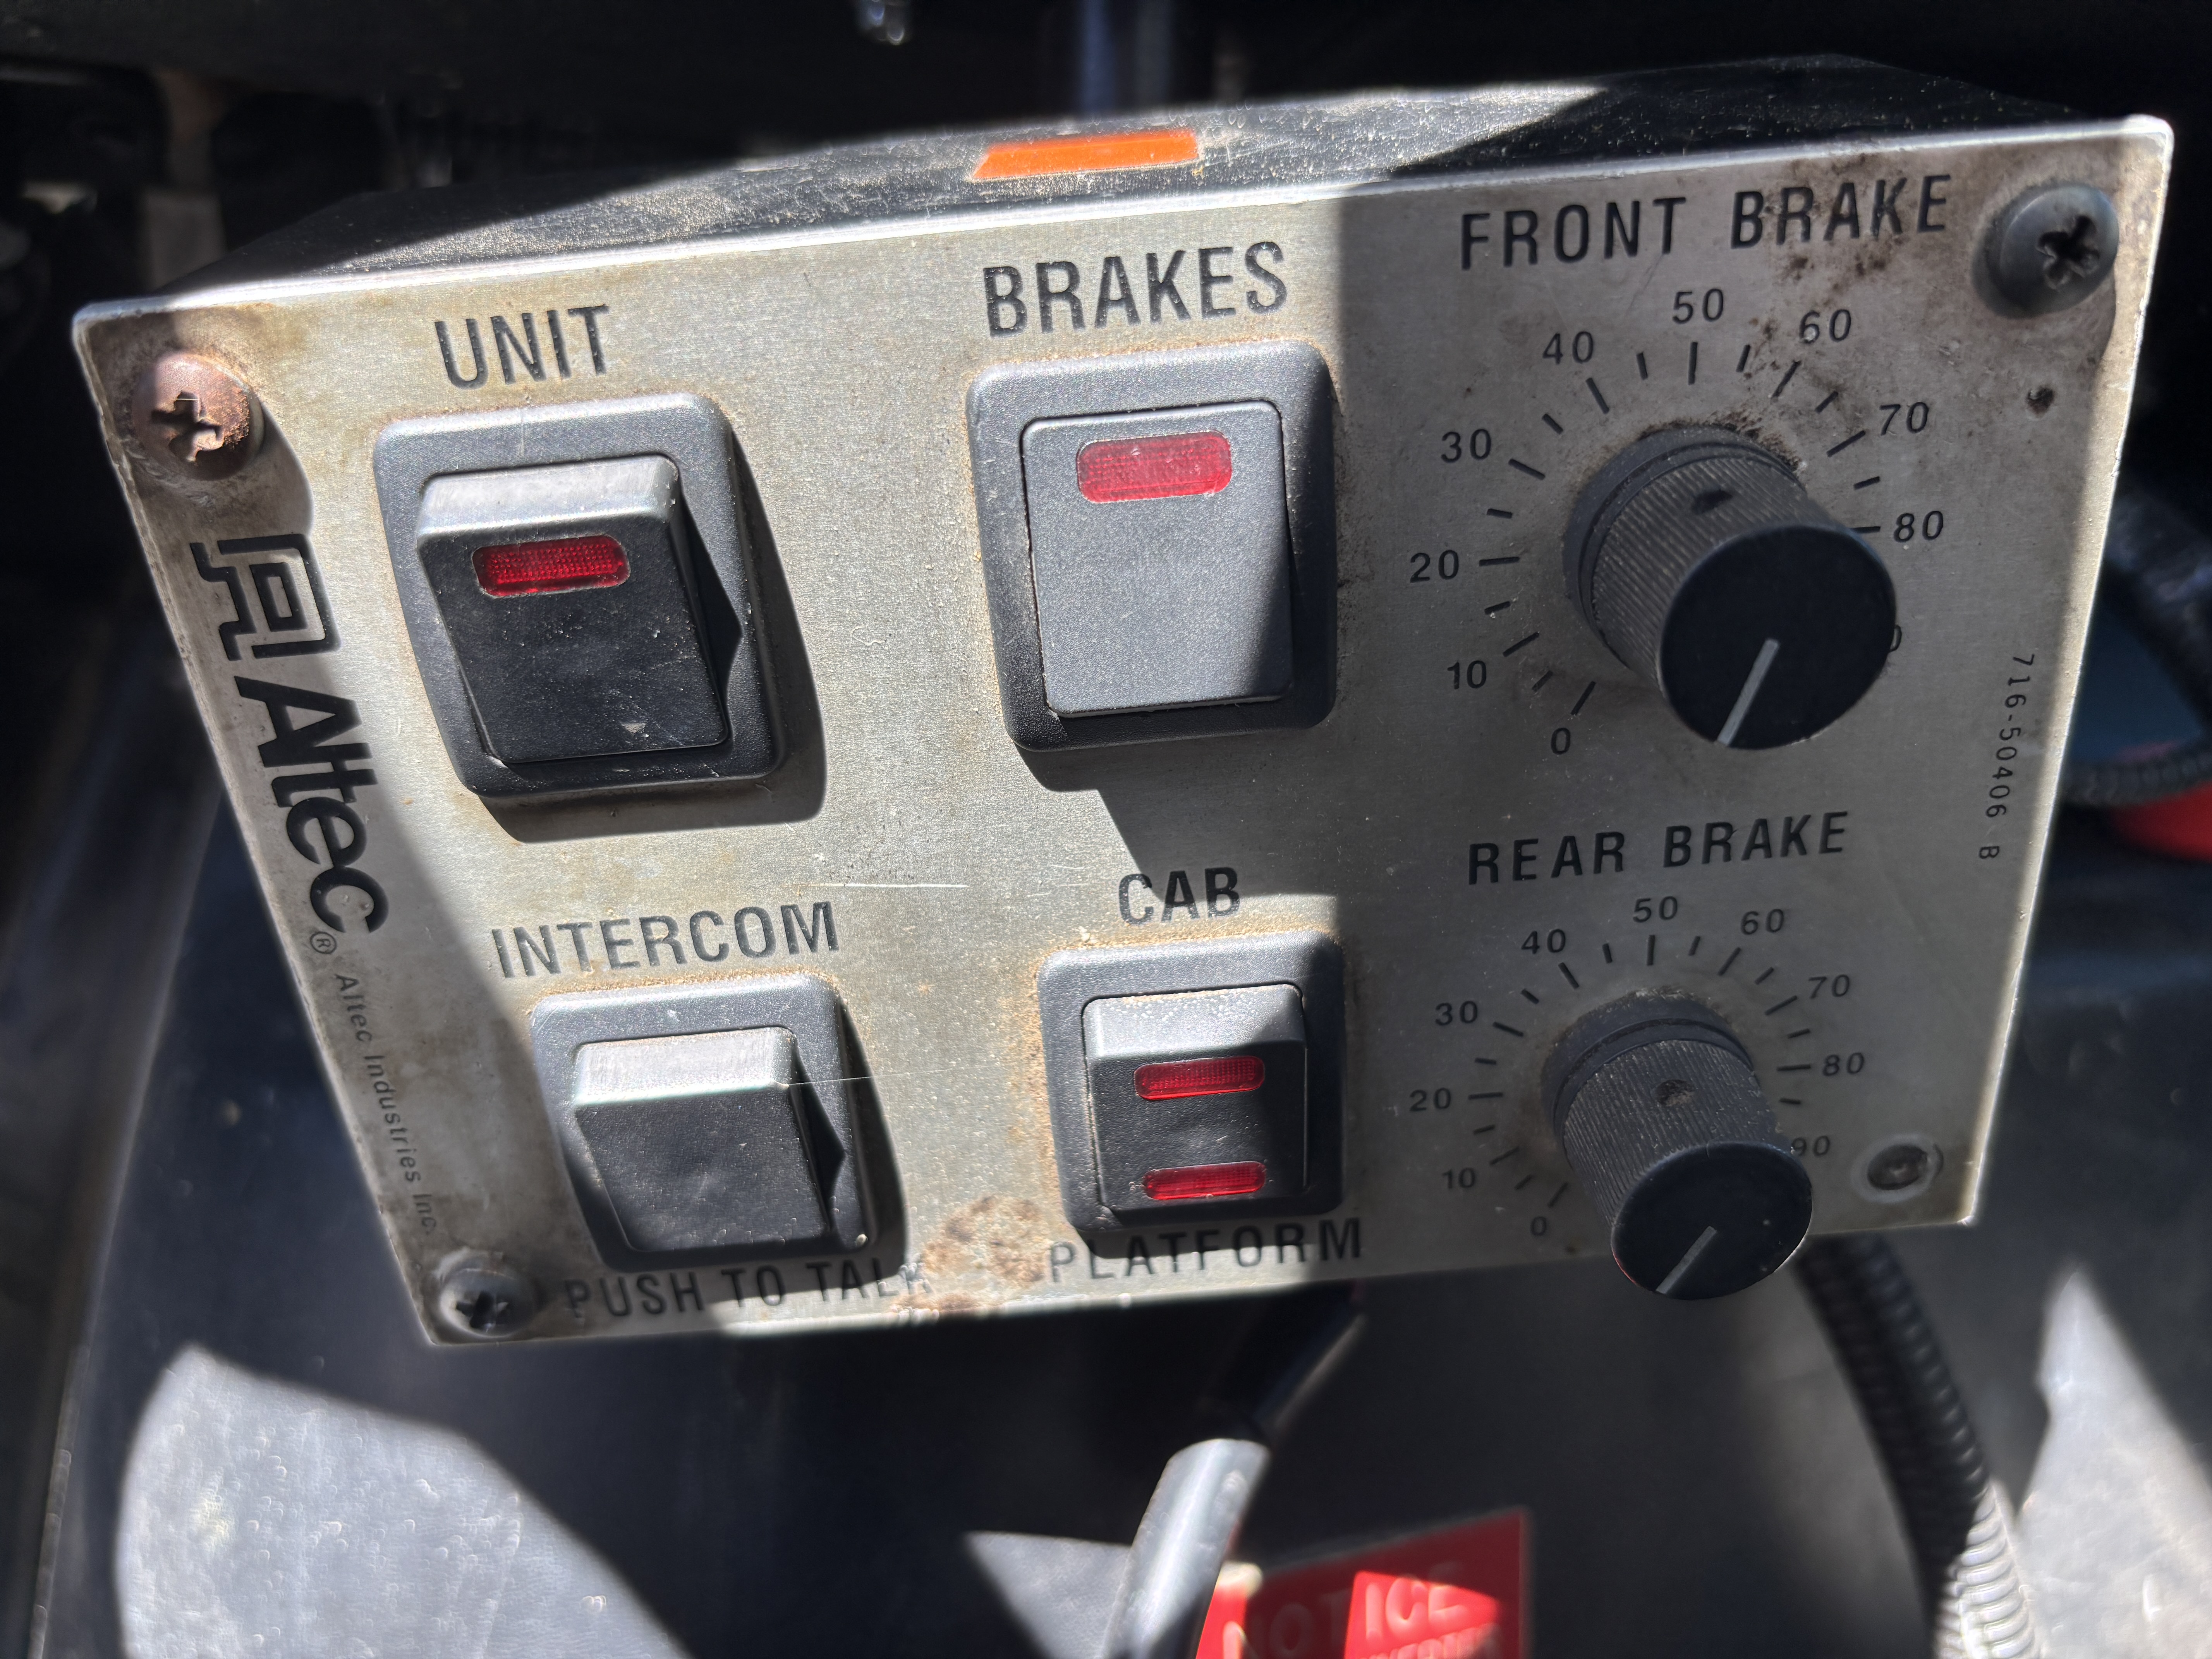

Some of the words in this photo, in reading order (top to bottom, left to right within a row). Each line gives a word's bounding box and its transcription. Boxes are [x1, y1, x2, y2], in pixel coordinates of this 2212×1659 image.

[1461, 196, 1686, 271] FRONT
[1731, 173, 1952, 249] BRAKE
[982, 240, 1287, 338] BRAKES
[1672, 287, 1724, 325] 50
[1798, 308, 1852, 346] 60
[434, 303, 610, 389] UNIT
[1542, 330, 1595, 364] 40
[1879, 401, 1930, 436] 70
[1441, 428, 1492, 463] 30
[1893, 510, 1944, 543] 80
[1410, 549, 1460, 583] 20
[1446, 659, 1487, 690] 10
[1550, 727, 1571, 755] 0
[1985, 653, 2035, 818] 716-50406
[233, 675, 388, 933] Altec
[1468, 831, 1625, 885] REAR
[1663, 811, 1848, 868] BRAKE
[1978, 845, 2000, 860] B
[1118, 867, 1241, 925] CAB
[1633, 895, 1679, 924] 50
[1740, 908, 1786, 936] 60
[491, 900, 840, 979] INTERCOM
[1521, 928, 1567, 955] 40
[1808, 974, 1851, 1000] 70
[1434, 1000, 1479, 1027] 30
[335, 973, 373, 1042] Altec
[364, 1054, 421, 1183] Industries
[1822, 1052, 1865, 1077] 80
[1409, 1087, 1452, 1113] 20
[1791, 1135, 1831, 1157] 90
[1442, 1167, 1478, 1190] 10
[1530, 1216, 1548, 1237] 0
[1048, 1217, 1362, 1283] PLATFORM
[564, 1271, 704, 1318] PUSH
[721, 1264, 786, 1308] TO
[805, 1257, 932, 1302] TALK
